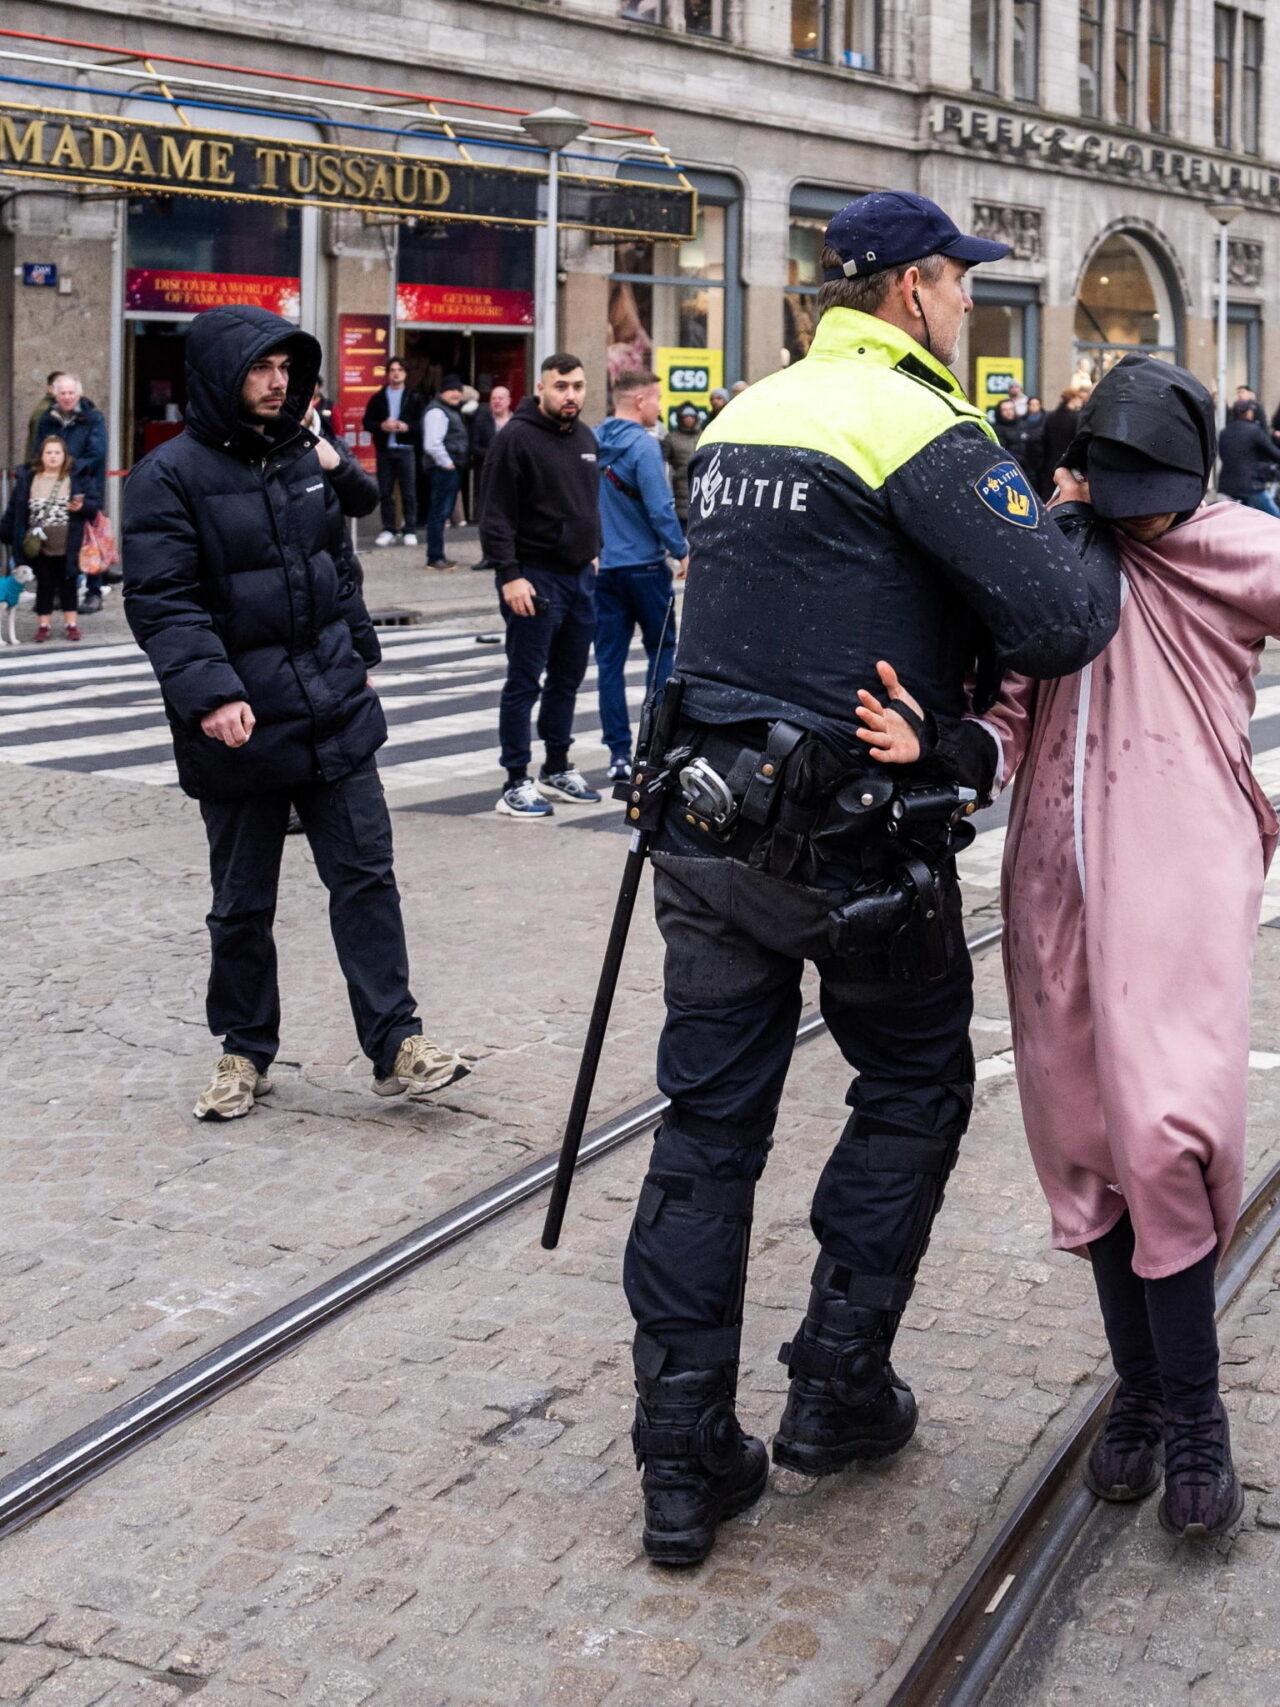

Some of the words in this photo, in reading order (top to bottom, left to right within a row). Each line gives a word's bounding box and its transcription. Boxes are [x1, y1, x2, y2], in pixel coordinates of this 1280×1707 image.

[931, 104, 1041, 154] PEEK
[0, 116, 235, 185] MADAME
[256, 148, 451, 206] TUSSAUD
[670, 369, 708, 390] €50
[690, 460, 810, 519] POLITIE
